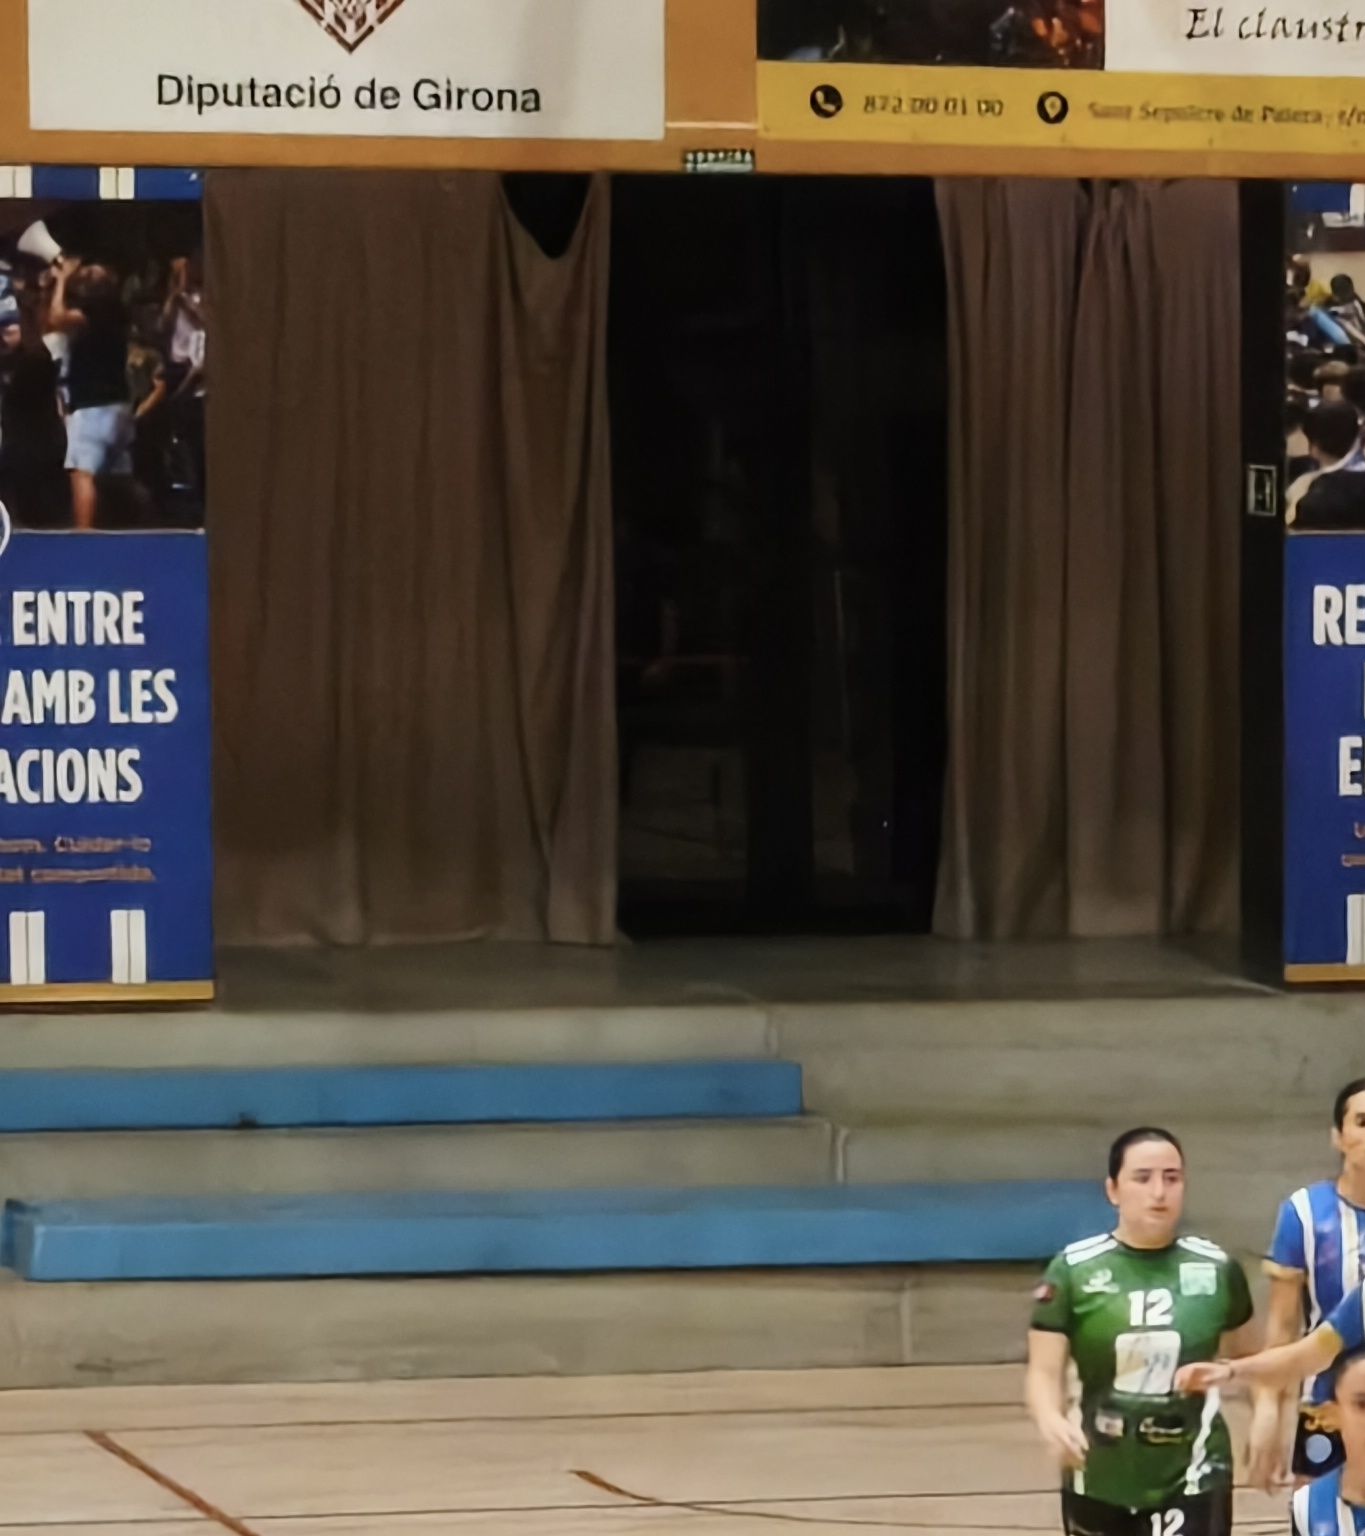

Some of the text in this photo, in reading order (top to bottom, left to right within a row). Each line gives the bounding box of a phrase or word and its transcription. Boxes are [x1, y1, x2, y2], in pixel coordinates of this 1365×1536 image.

[1186, 7, 1223, 39] El
[156, 73, 542, 115] Diputació de Girona
[13, 590, 145, 646] ENTRE
[1, 668, 178, 724] AMB LES
[1128, 1288, 1174, 1327] 12
